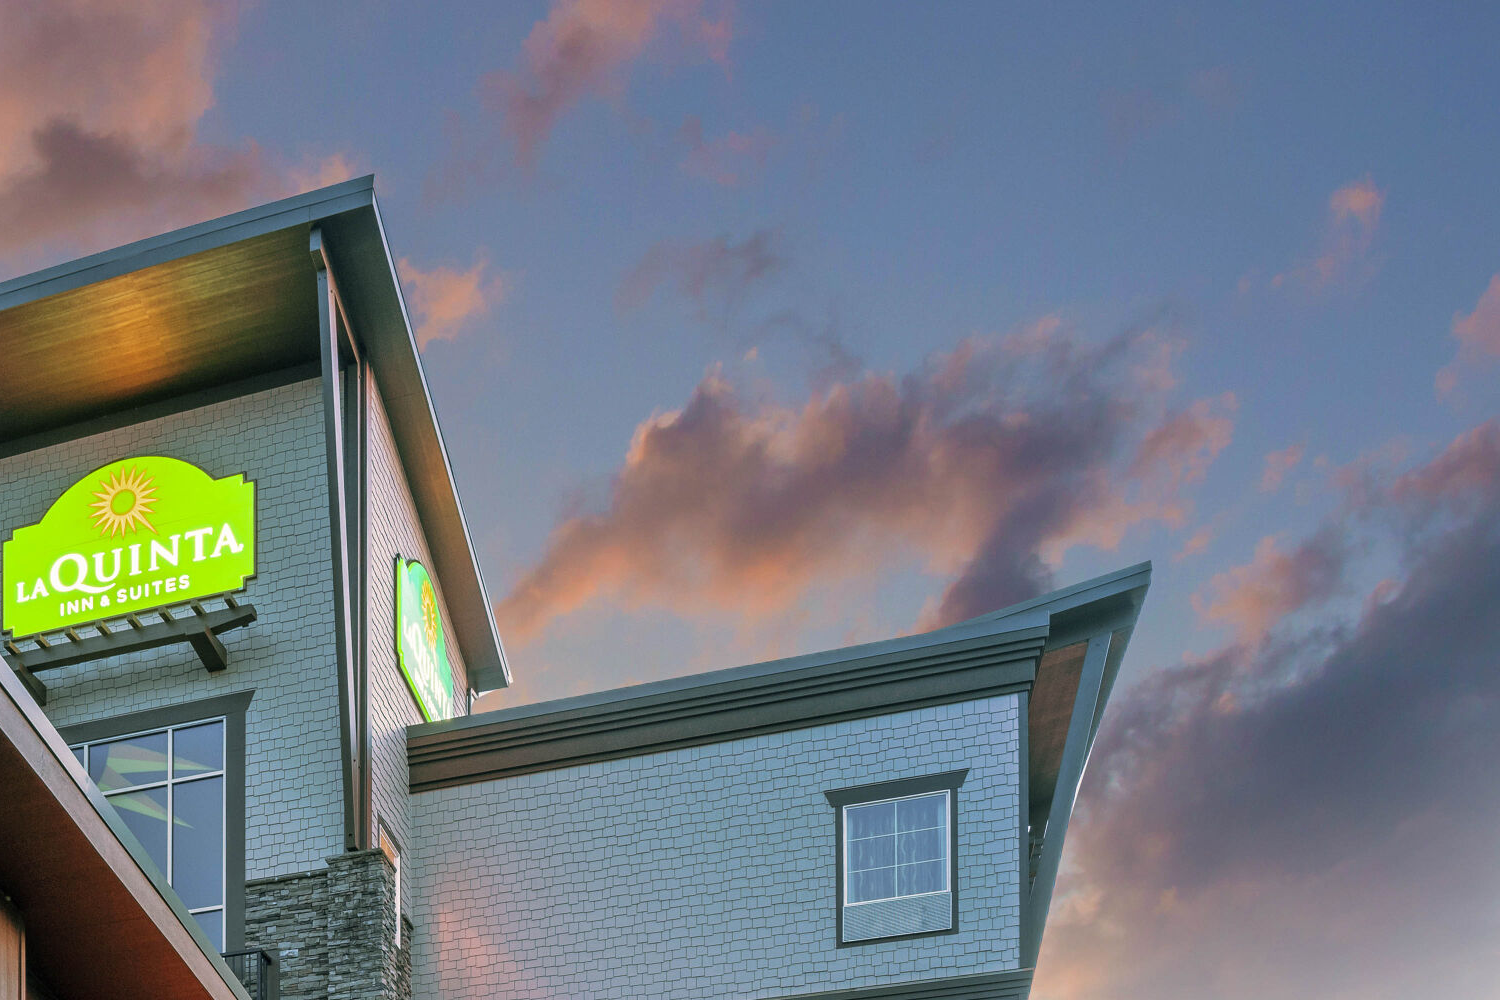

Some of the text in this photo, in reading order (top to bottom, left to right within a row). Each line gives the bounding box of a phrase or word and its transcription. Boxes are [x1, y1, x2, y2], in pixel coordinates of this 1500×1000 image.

[16, 523, 244, 603] LA QUINTA
[59, 575, 190, 617] INN & SUITES
